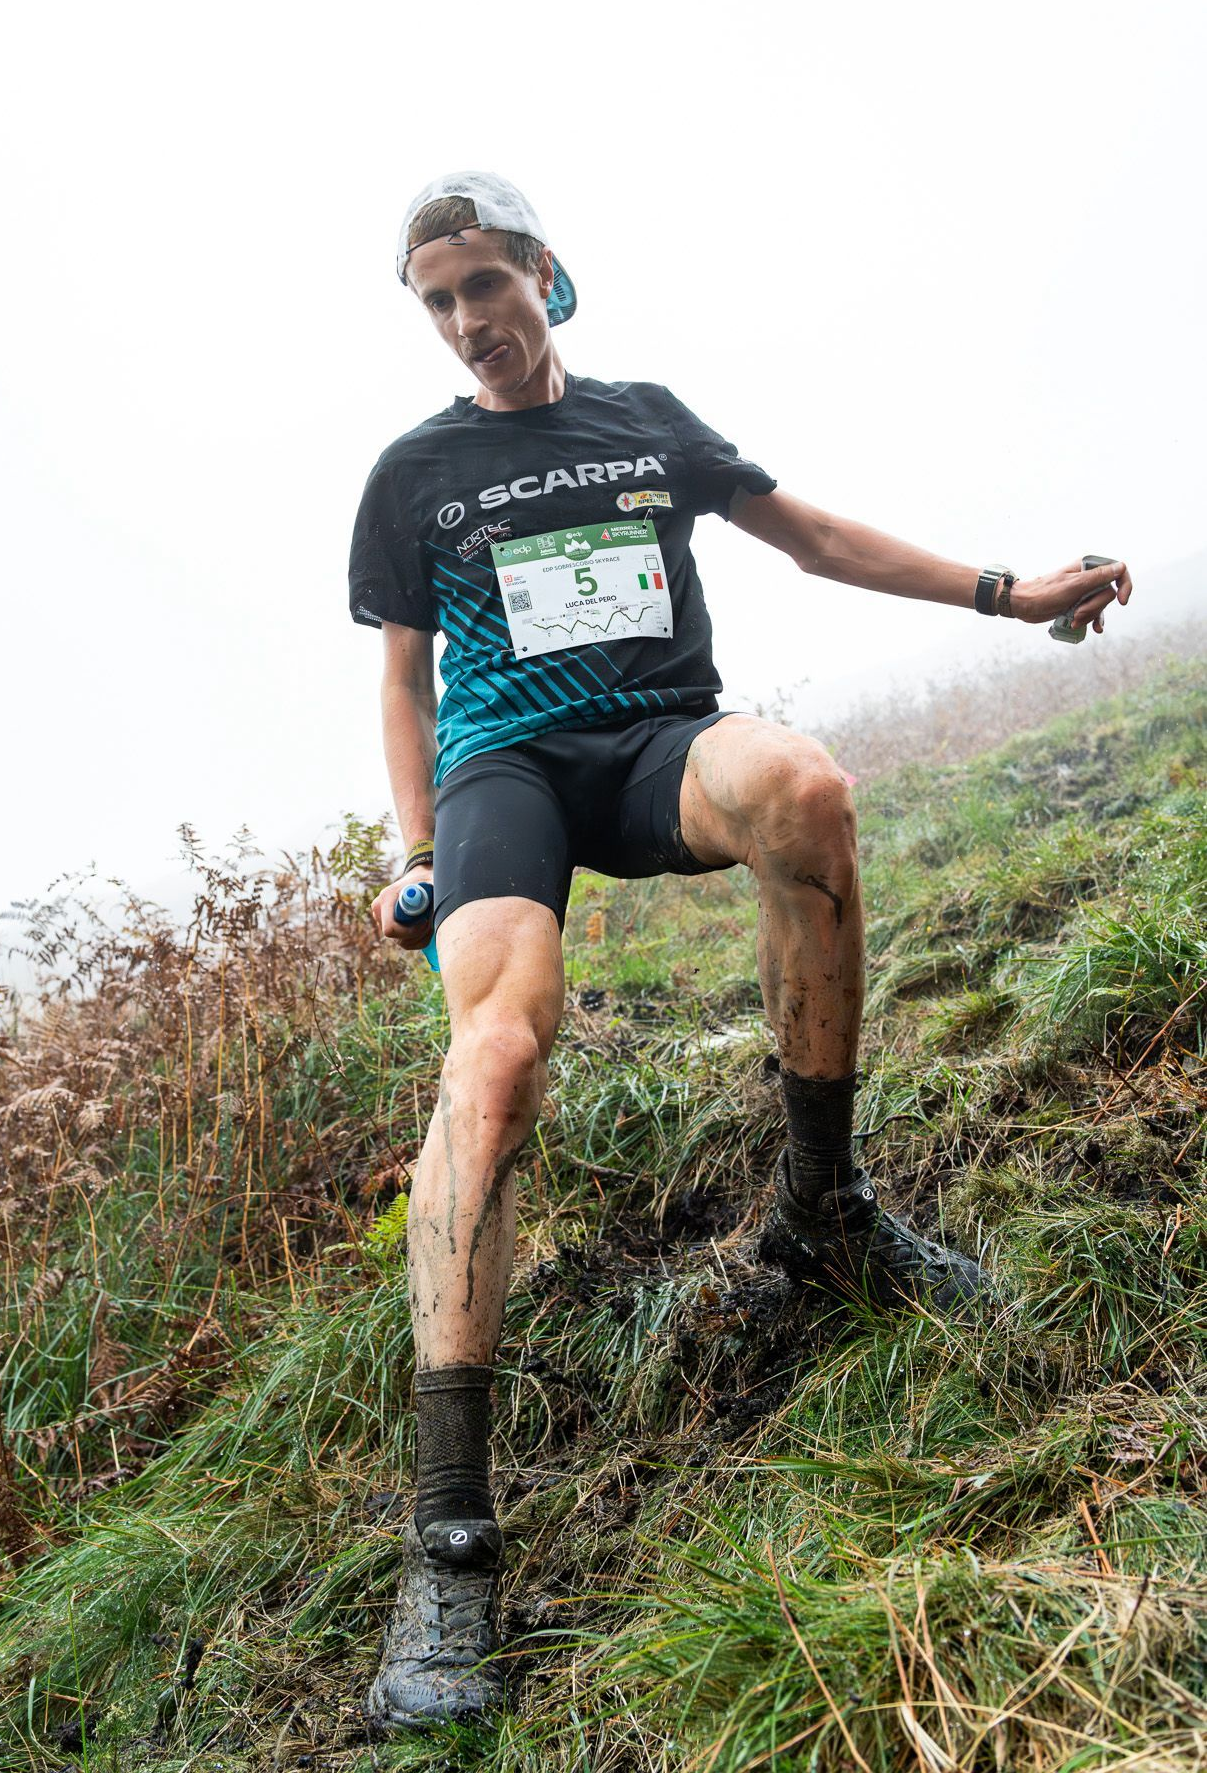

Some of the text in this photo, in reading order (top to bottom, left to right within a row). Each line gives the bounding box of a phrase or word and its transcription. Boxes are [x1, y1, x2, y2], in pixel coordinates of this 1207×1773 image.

[456, 518, 511, 555] NORTEC
[612, 529, 648, 538] SKYRUNNER
[513, 544, 532, 555] edp
[554, 560, 594, 571] SOBRESCOBIO
[595, 556, 620, 564] SKYRACE
[574, 566, 598, 596] 5
[565, 600, 585, 609] LUCA
[598, 595, 617, 603] PERO
